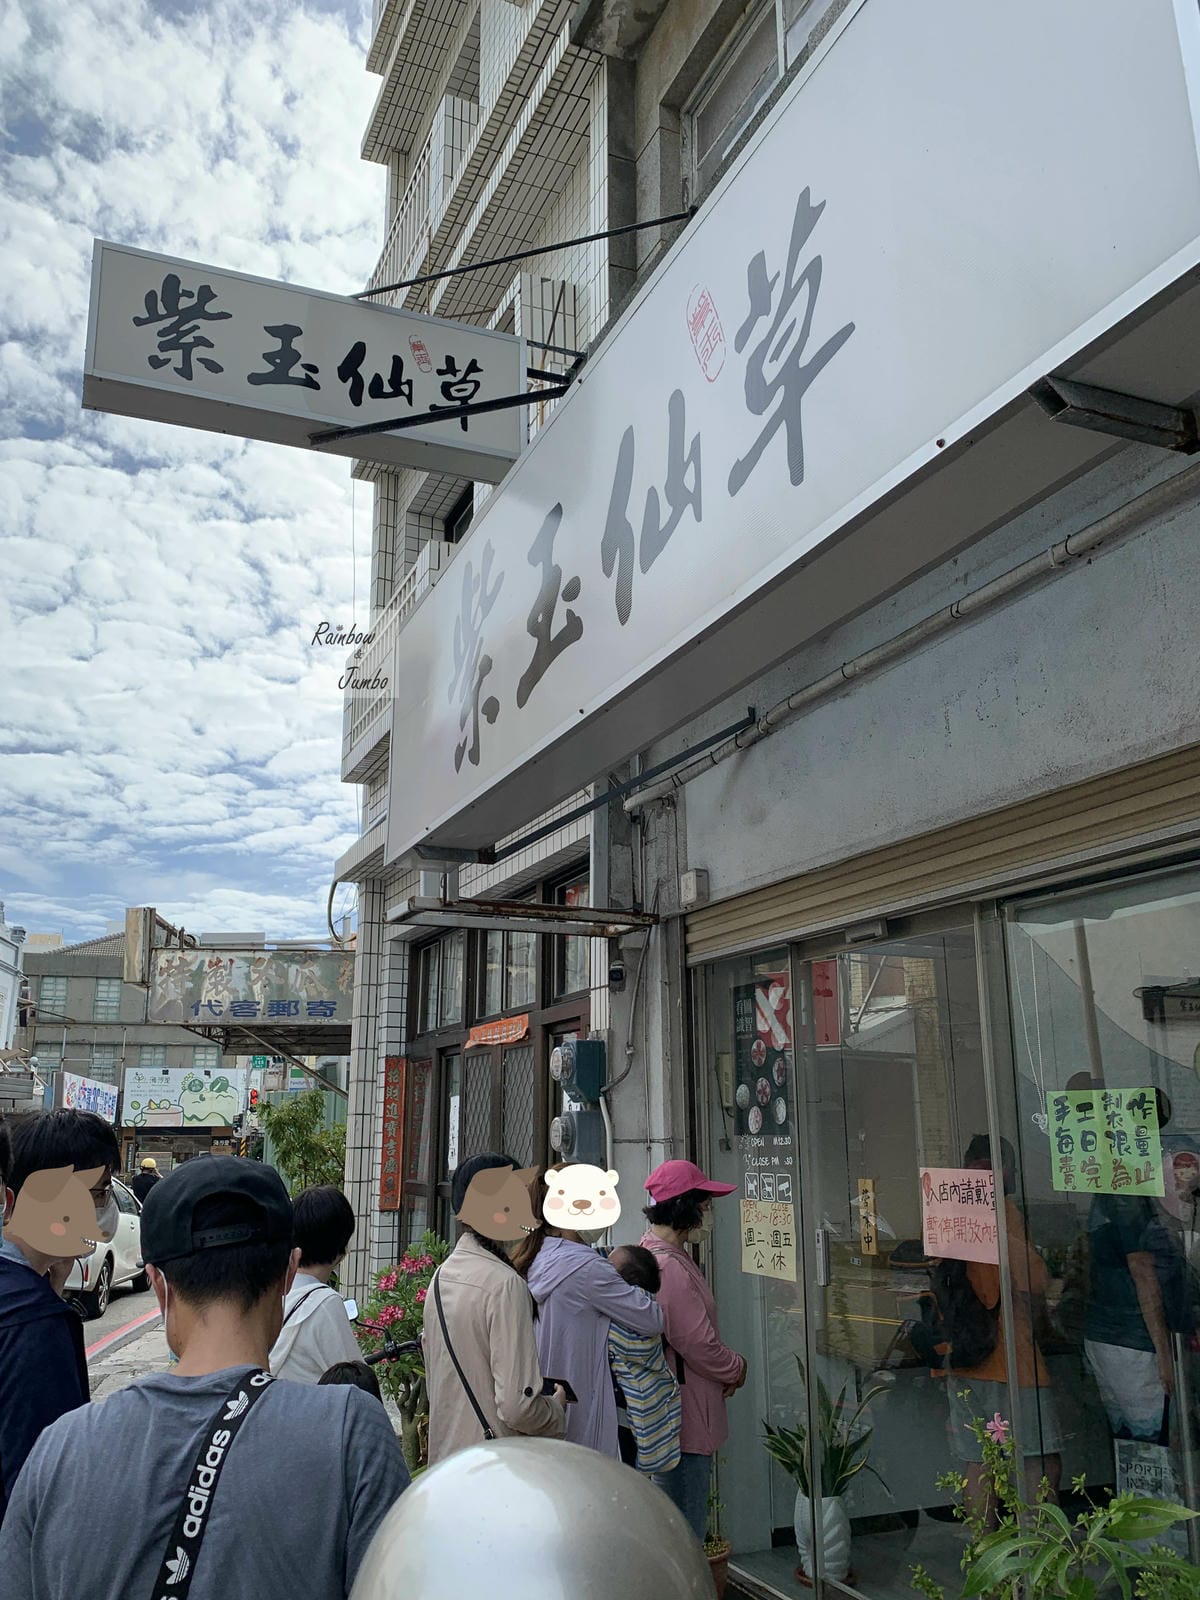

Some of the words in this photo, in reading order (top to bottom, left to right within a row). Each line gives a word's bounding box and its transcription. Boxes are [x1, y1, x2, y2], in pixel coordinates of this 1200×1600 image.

[133, 273, 483, 431] 紫玉仙草
[449, 187, 856, 774] 紫玉仙草
[190, 1000, 338, 1018] 代客郵寄
[1053, 1092, 1154, 1129] 手工製作
[751, 1138, 765, 1147] OPEN
[1055, 1125, 1152, 1156] 每日限量
[751, 1156, 770, 1166] CLOSE
[1059, 1156, 1156, 1191] 賣完為止
[743, 1200, 758, 1210] OPEN
[770, 1203, 789, 1212] CLOSE
[753, 1249, 787, 1270] 公休
[183, 1429, 231, 1538] adidas
